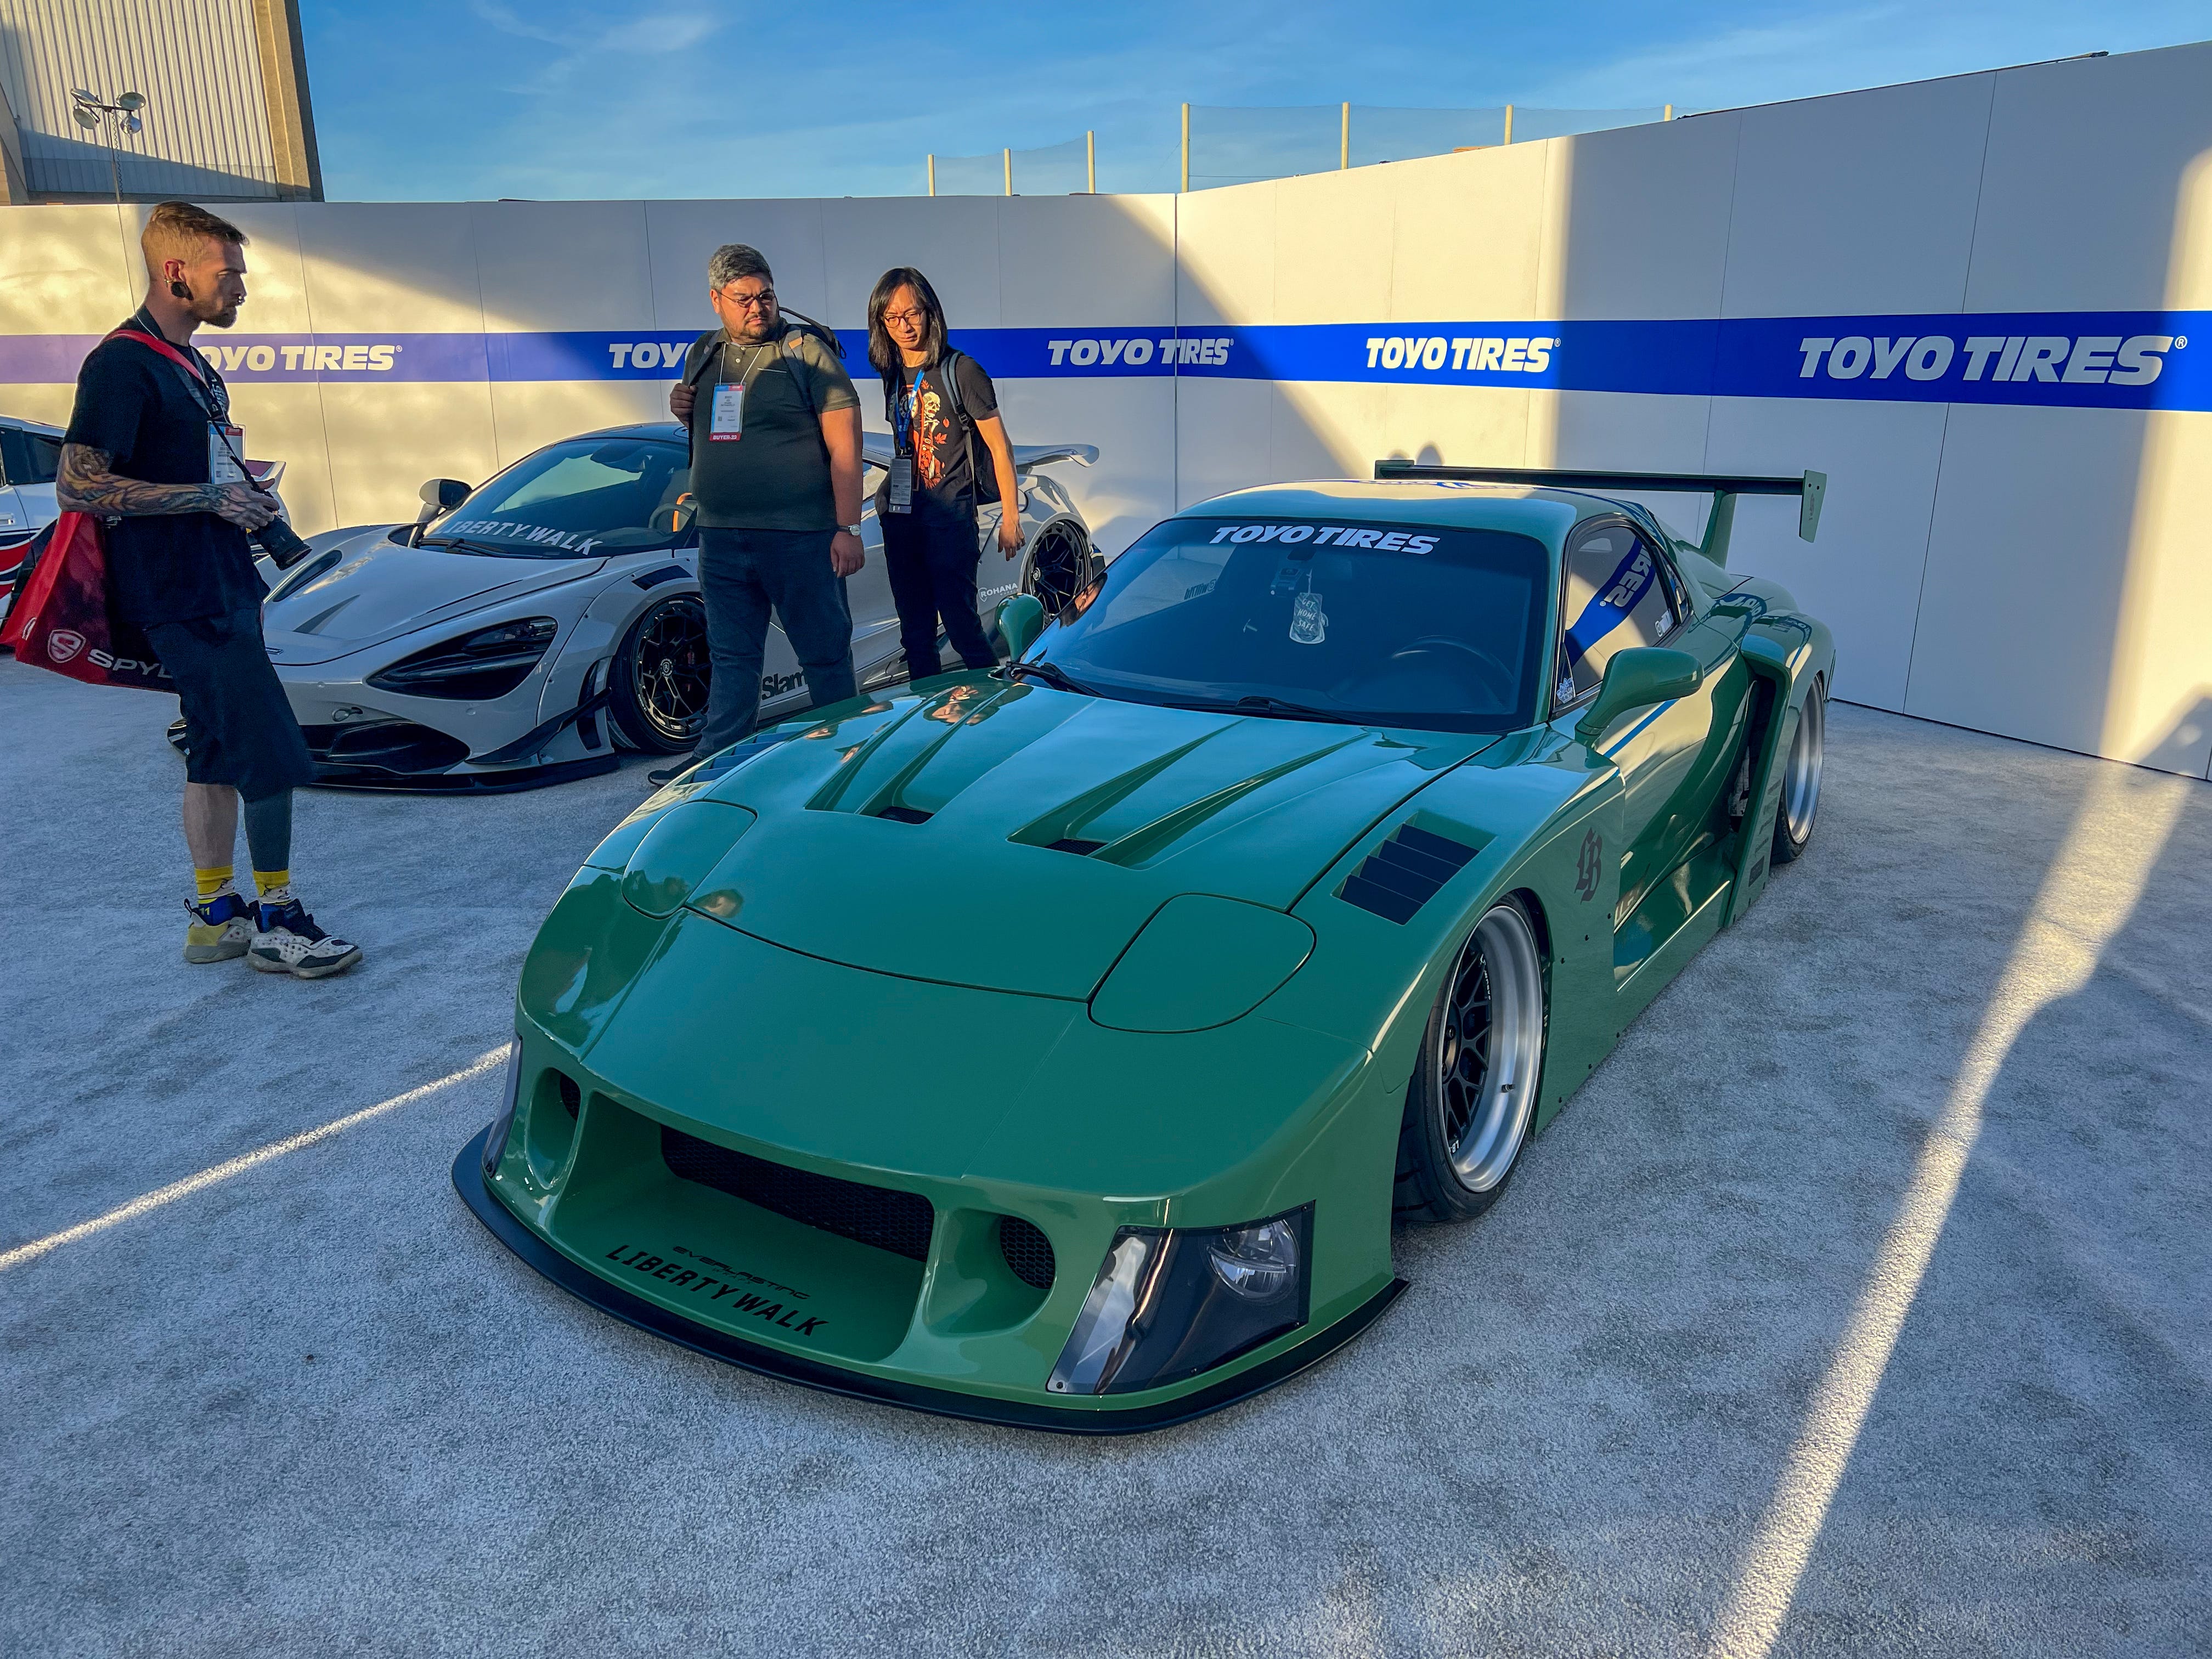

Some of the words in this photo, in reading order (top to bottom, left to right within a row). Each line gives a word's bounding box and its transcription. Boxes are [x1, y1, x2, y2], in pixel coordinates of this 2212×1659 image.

[196, 346, 275, 371] OYO
[609, 342, 695, 368] TOY
[1047, 339, 1154, 365] TOYO
[1366, 337, 1448, 370] TOYO
[1799, 336, 1955, 380] TOYO
[434, 521, 529, 538] LIBERTY
[525, 527, 603, 555] WALK
[1209, 526, 1314, 544] TOYO
[1313, 527, 1441, 555] TIRES
[980, 583, 1018, 598] ROHANA
[1302, 599, 1316, 608] GET
[1297, 608, 1317, 620] HOME
[1298, 619, 1315, 631] SAFE
[605, 1245, 740, 1300] LIBERTY
[732, 1293, 830, 1336] WALK
